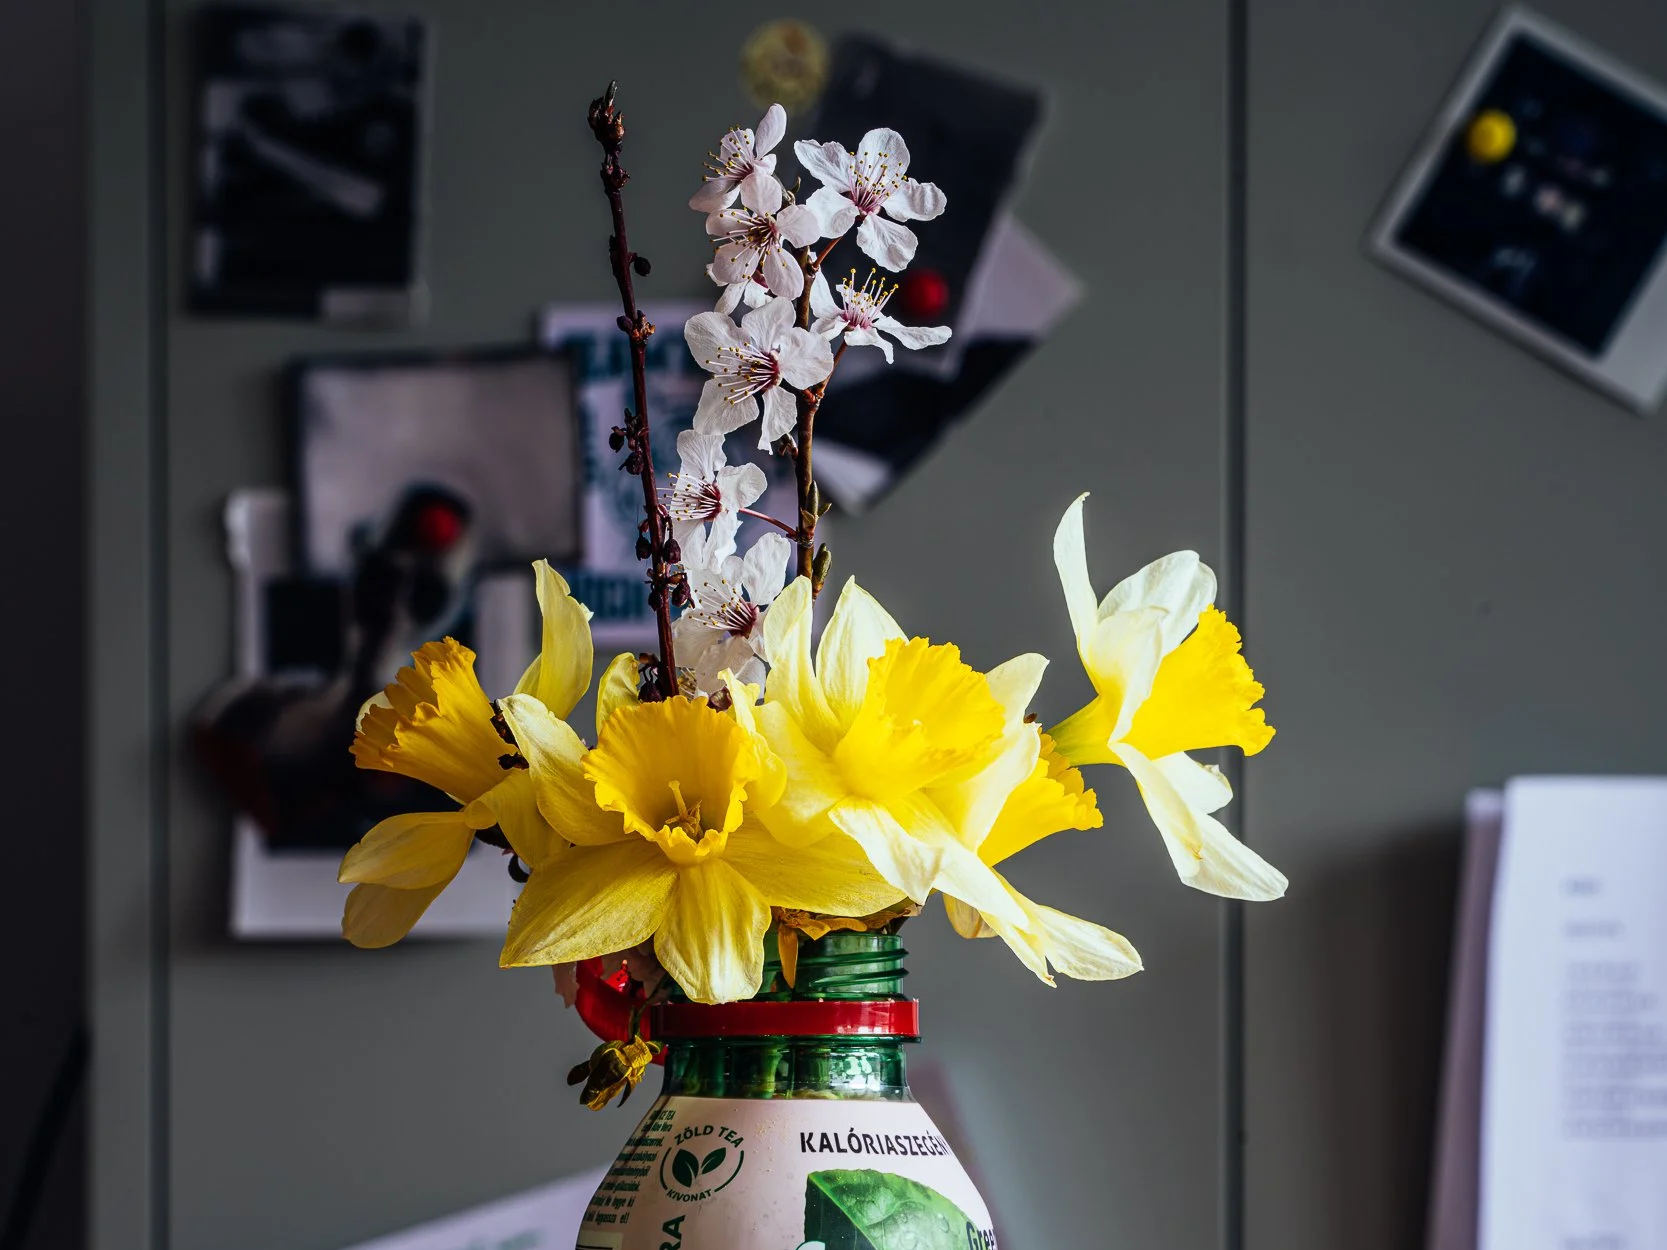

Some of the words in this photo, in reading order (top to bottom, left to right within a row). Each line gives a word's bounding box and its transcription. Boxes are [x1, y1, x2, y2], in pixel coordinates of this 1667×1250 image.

[674, 1125, 714, 1146] ZÖLD
[718, 1126, 744, 1148] TEA
[800, 1127, 952, 1157] KALÓRIASZEGÉN
[666, 1188, 712, 1202] KIVONAT
